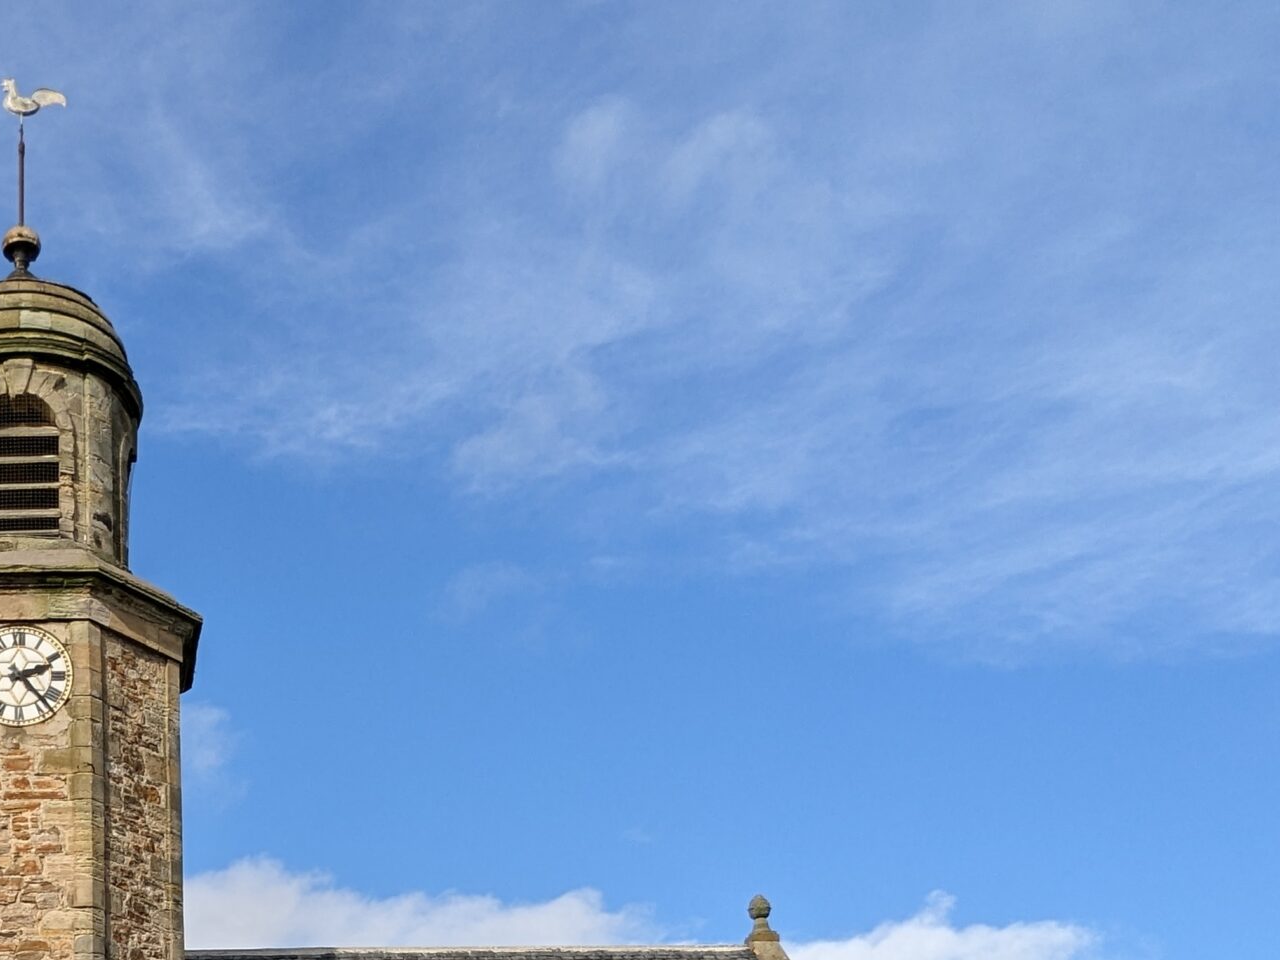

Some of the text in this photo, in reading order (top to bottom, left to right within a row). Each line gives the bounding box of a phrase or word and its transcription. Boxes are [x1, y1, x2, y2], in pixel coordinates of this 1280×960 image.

[12, 632, 26, 646] XII
[35, 638, 44, 650] I
[46, 652, 61, 663] II
[51, 671, 65, 681] III
